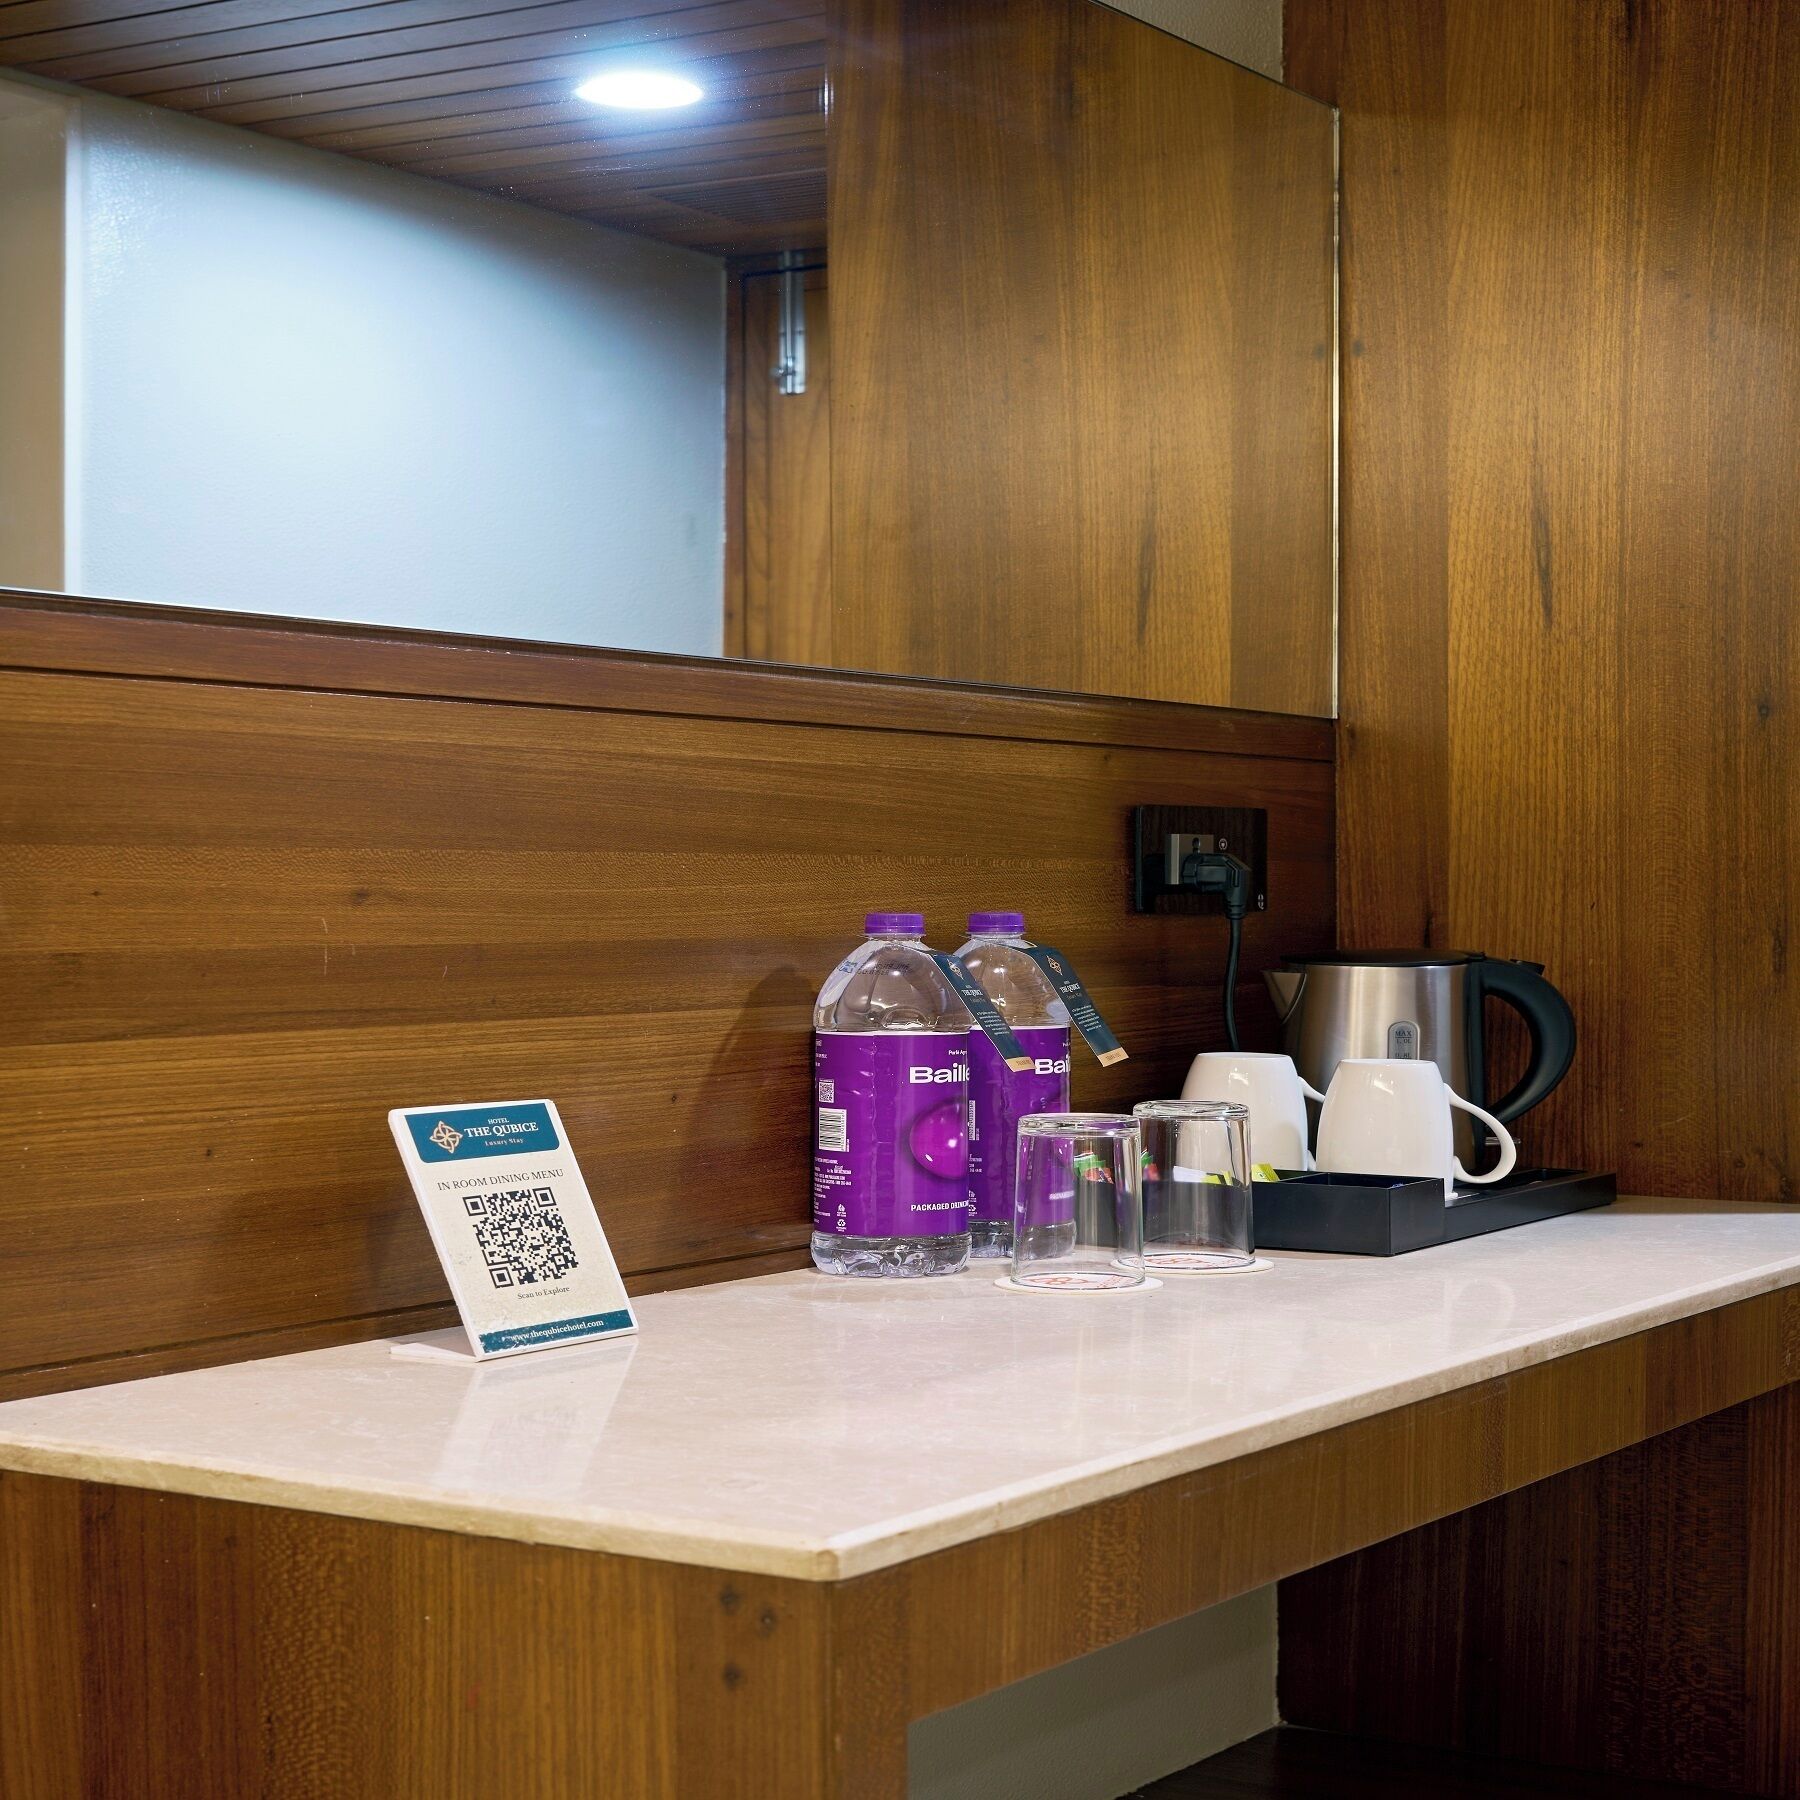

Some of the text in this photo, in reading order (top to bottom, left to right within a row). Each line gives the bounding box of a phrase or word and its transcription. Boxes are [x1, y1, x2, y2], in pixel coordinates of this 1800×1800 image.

[487, 1117, 510, 1125] HOTEL
[464, 1122, 539, 1138] THE QUBICE
[484, 1137, 524, 1147] Luxury Stay
[437, 1168, 564, 1191] IN ROOM DINING MENU
[910, 1201, 950, 1212] PACKAGED
[517, 1285, 570, 1300] Scan to Explore
[510, 1319, 605, 1341] www.thequbicehotel.com
